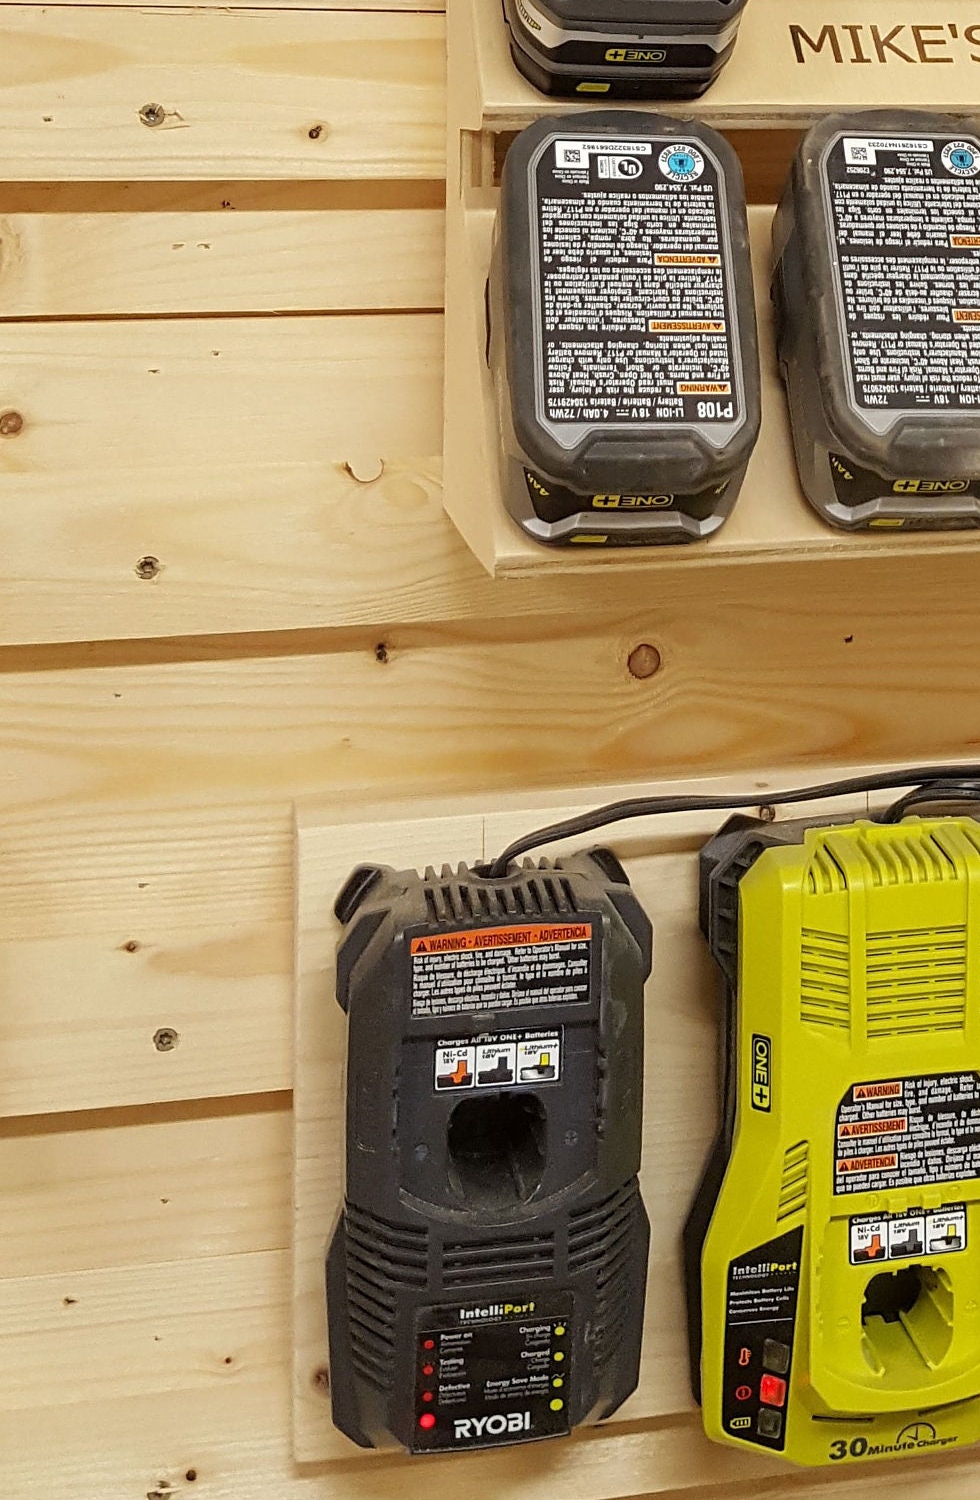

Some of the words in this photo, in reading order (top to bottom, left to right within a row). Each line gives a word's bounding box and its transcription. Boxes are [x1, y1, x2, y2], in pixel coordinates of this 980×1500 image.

[605, 49, 665, 62] ONE+
[652, 322, 710, 330] AVERTISSEMENT
[569, 385, 591, 394] injury,
[680, 384, 717, 392] WARNING
[623, 397, 651, 406] Batterie
[657, 397, 683, 406] Battery
[864, 394, 888, 404] 72Wh
[935, 395, 950, 404] 18V
[550, 408, 574, 417] 72Wh
[583, 408, 609, 417] 4.0Ah
[656, 407, 683, 417] LI-ION
[697, 402, 733, 418] P108
[527, 473, 549, 496] 4Ah
[893, 480, 969, 492] ONE+
[593, 495, 673, 507] ONE+
[430, 938, 466, 950] WARNING
[475, 932, 531, 946] AVERTISSEMENT
[539, 927, 586, 941] ADVERTENCIA
[438, 1039, 468, 1047] Charges
[525, 1031, 558, 1039] Batteries
[443, 1049, 467, 1058] Ni-Cd
[754, 1039, 769, 1107] ONE+
[866, 1085, 900, 1097] WARNING
[852, 1119, 905, 1135] AVERTISSEMENT
[850, 1156, 895, 1170] ADVERTENCIA
[858, 1225, 880, 1233] Ni-Cd
[733, 1262, 797, 1275] IntelliPort
[460, 1302, 535, 1319] IntelliPort
[440, 1333, 462, 1341] Power
[439, 1383, 470, 1391] Defective
[454, 1412, 531, 1438] RYOBI
[829, 1437, 867, 1460] 30
[868, 1442, 915, 1455] Minute
[917, 1436, 958, 1447] Charger
